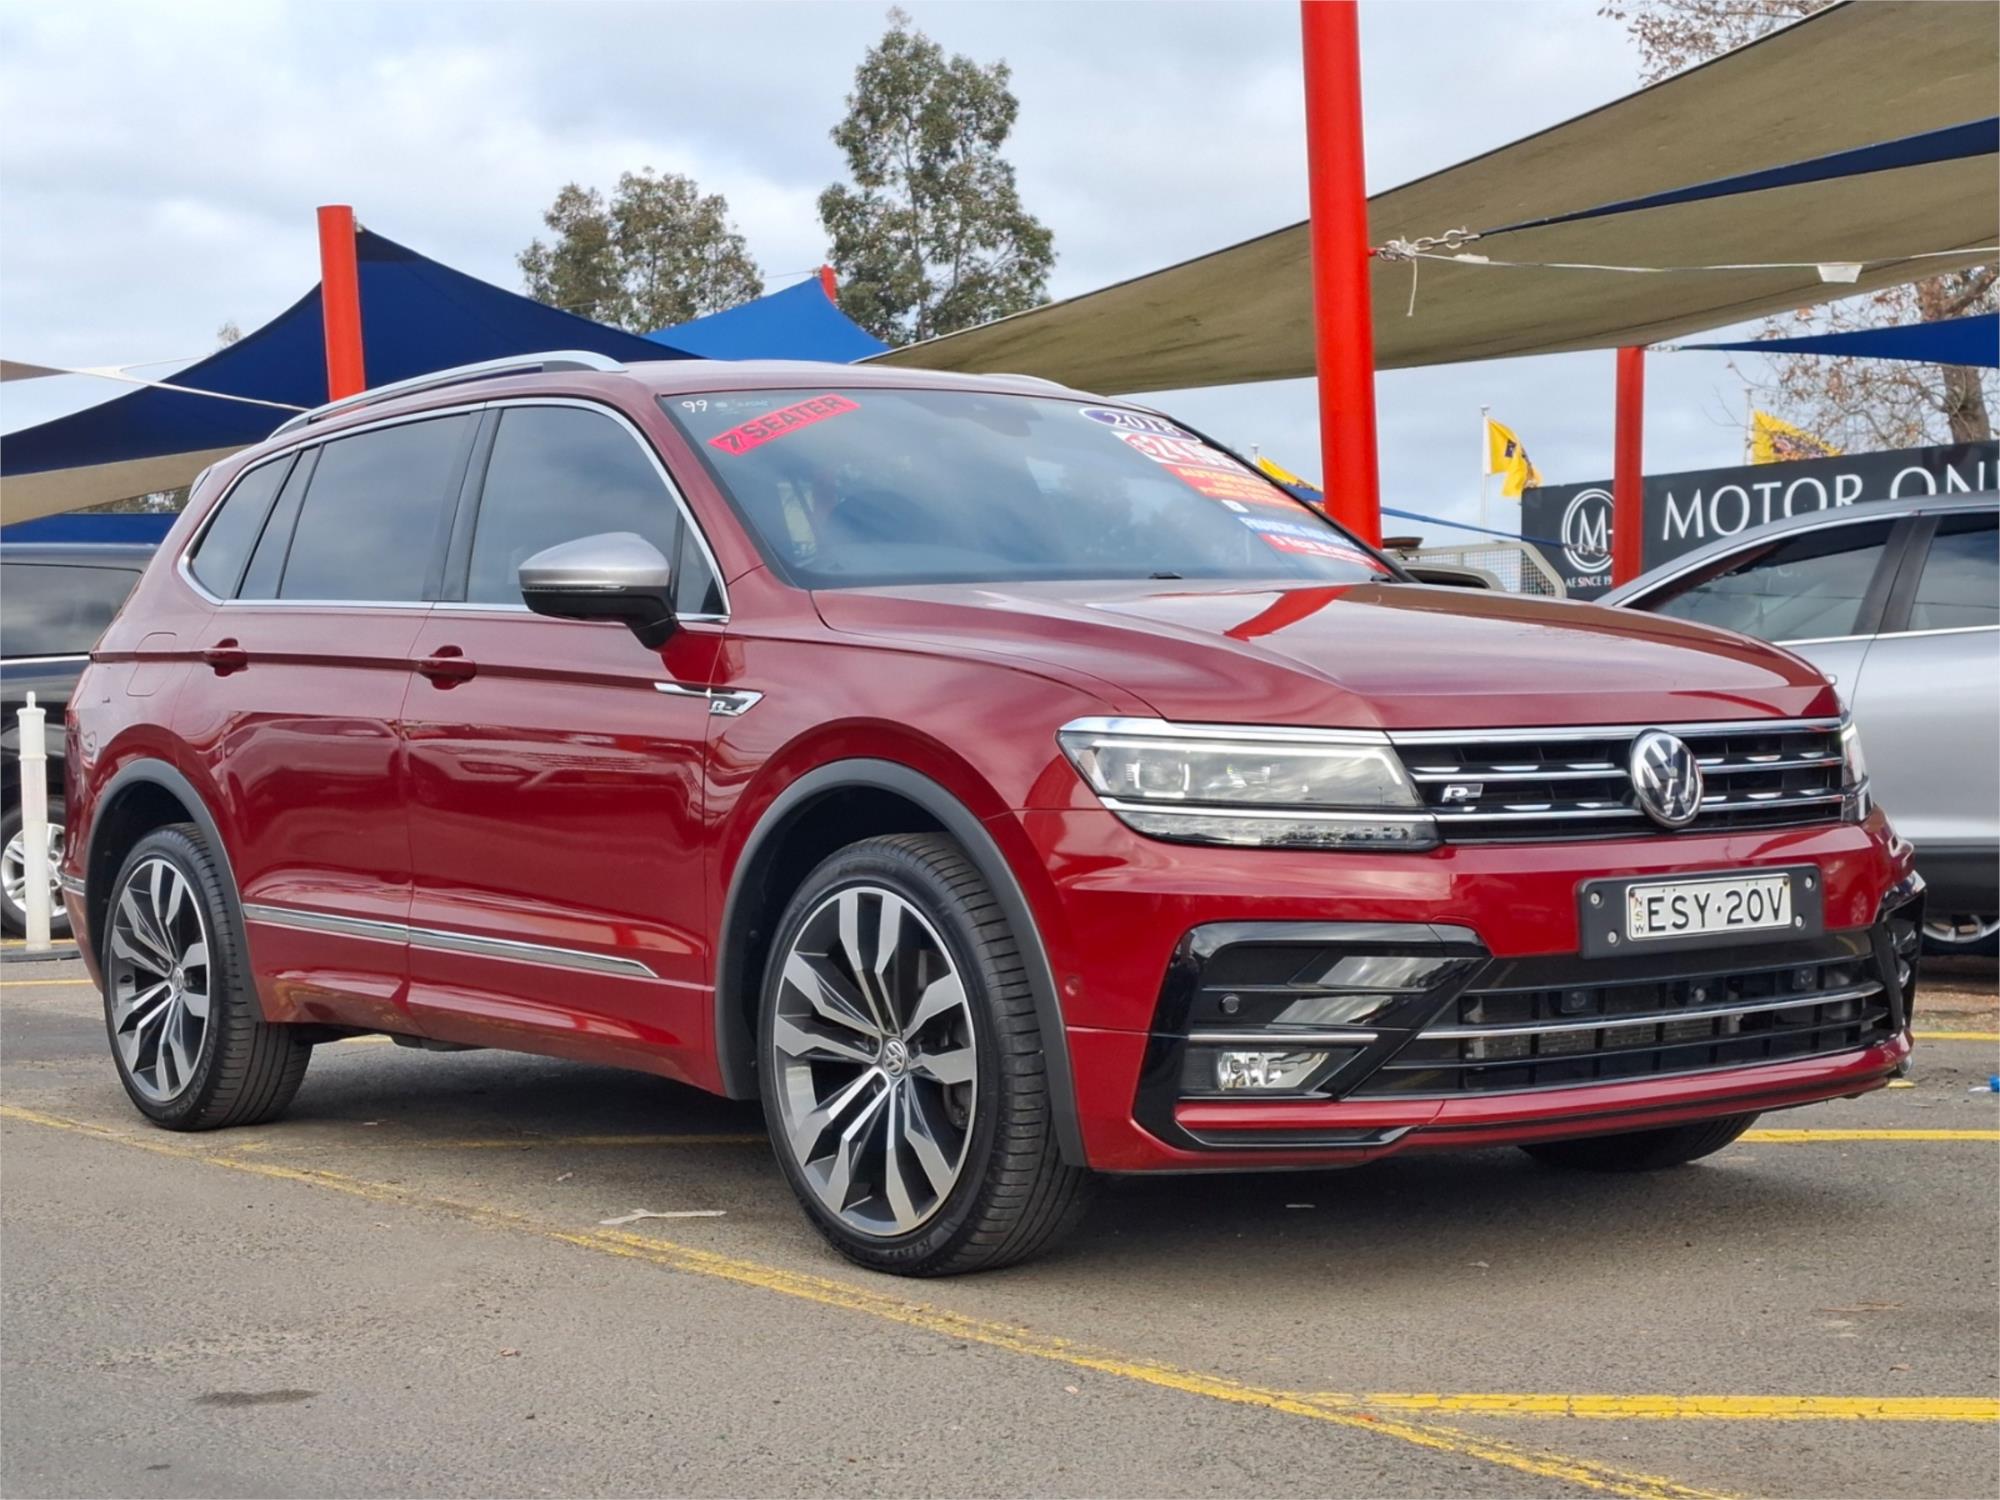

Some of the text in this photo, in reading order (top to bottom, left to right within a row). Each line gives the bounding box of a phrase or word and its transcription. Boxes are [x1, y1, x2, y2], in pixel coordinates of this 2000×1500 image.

[717, 395, 846, 450] 7 SEATER
[1662, 459, 2000, 542] MOTOR ON
